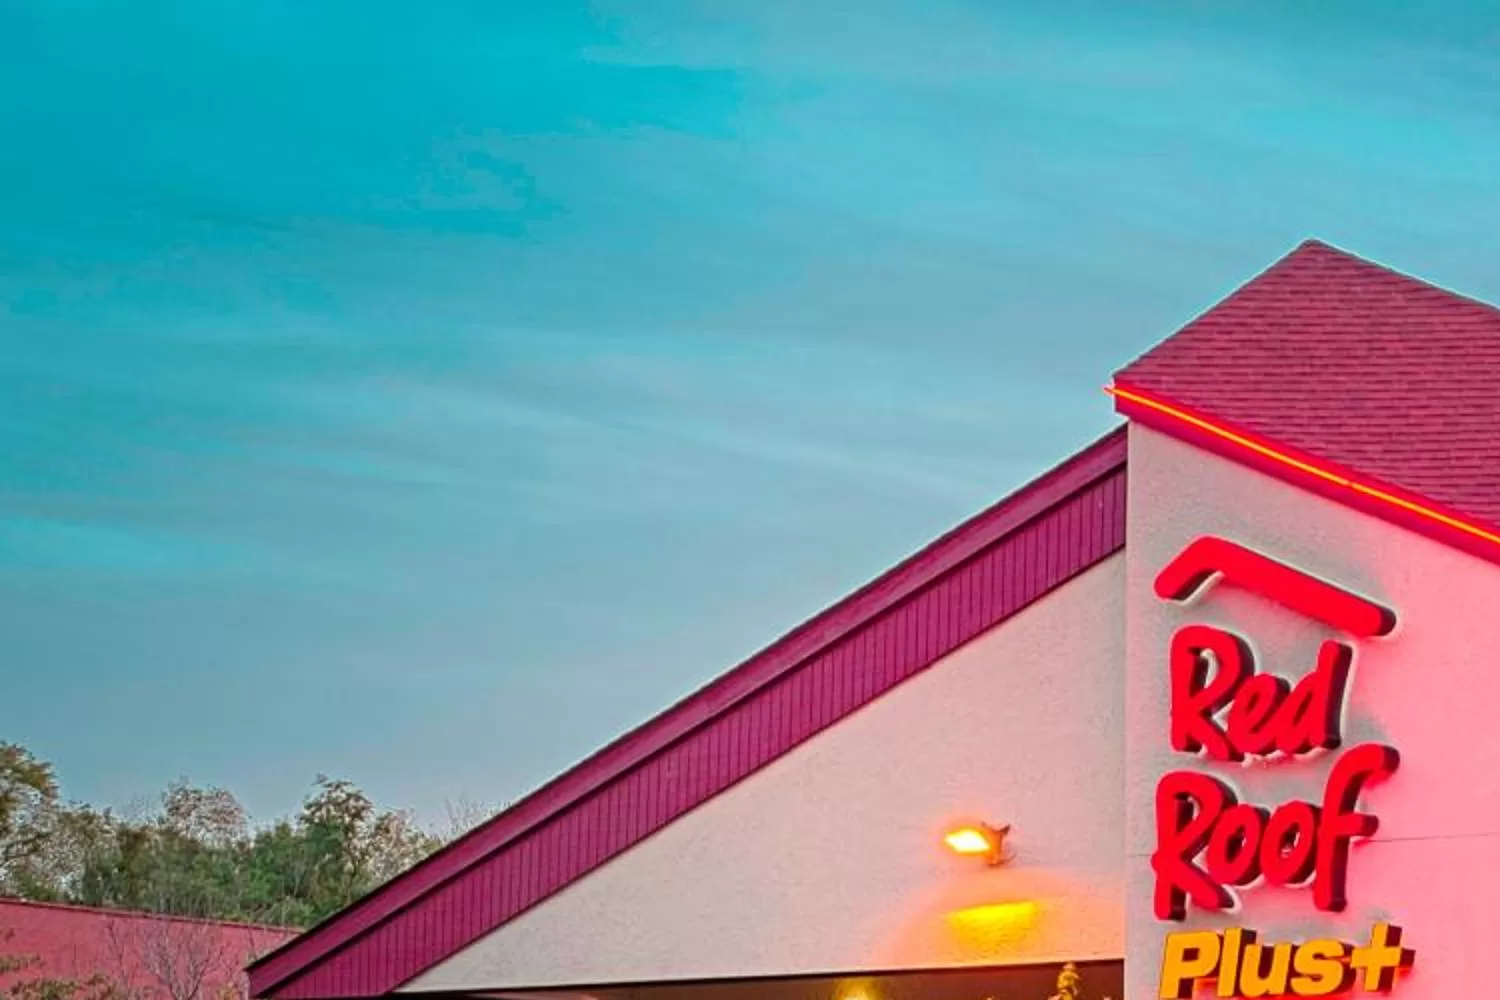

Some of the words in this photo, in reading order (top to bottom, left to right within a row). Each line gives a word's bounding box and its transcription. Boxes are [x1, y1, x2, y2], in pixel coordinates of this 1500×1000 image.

[1171, 626, 1353, 761] Red
[1151, 743, 1399, 920] Roof
[1159, 923, 1412, 1000] Plus+
